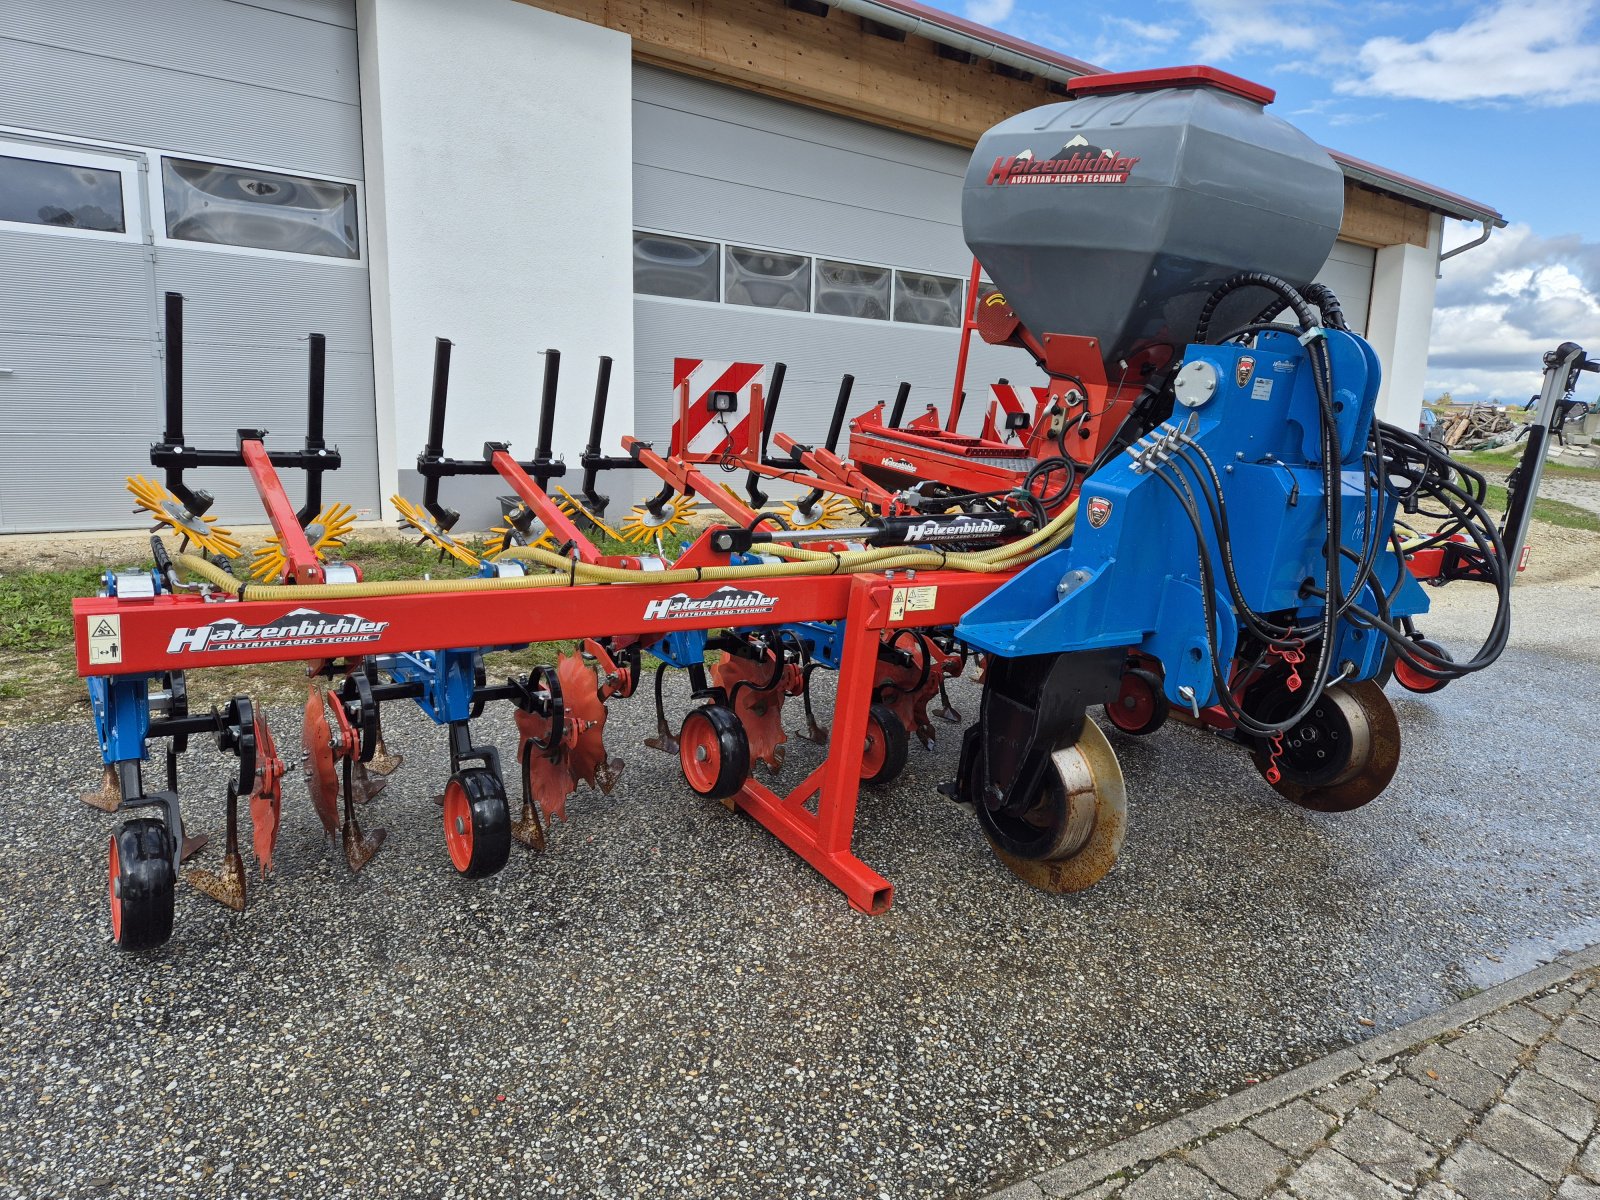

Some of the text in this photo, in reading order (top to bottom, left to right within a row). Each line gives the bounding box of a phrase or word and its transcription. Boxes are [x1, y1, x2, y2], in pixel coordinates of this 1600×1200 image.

[987, 152, 1140, 185] Hatzenbichler
[1011, 174, 1122, 184] AUSTRIAN-AGRO-TECHNIK
[904, 522, 1006, 541] Hatzenbichler
[643, 593, 778, 620] Hatzenbichler
[674, 607, 767, 618] AUSTRIAN-AGRO-TECHNIK
[166, 619, 389, 653] Hatzenbichler
[218, 635, 371, 650] AUSTRIAN-AGRO-TECHNIK
